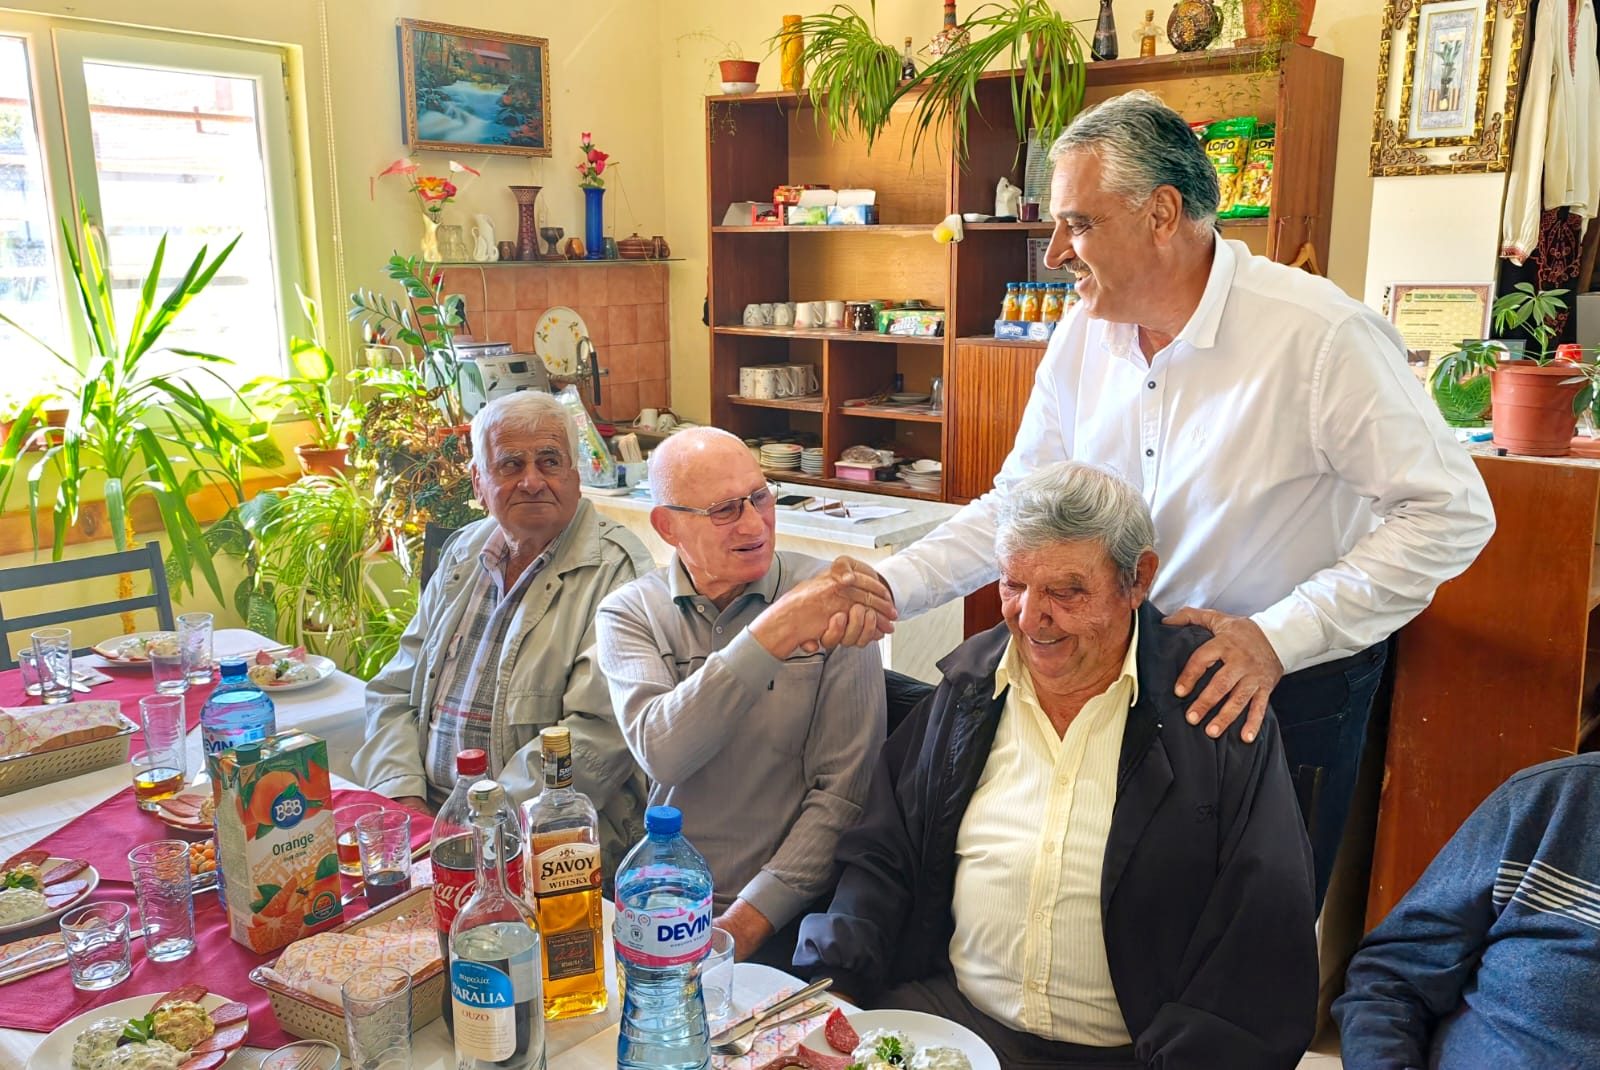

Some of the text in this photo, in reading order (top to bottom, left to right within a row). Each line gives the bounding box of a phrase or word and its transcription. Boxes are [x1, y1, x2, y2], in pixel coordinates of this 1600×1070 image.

[275, 799, 303, 822] BBB
[272, 832, 315, 856] Orange
[540, 856, 595, 880] SAVOY
[549, 876, 588, 889] WHISKY
[657, 909, 712, 943] DEVIN
[452, 982, 506, 1004] PARALIA
